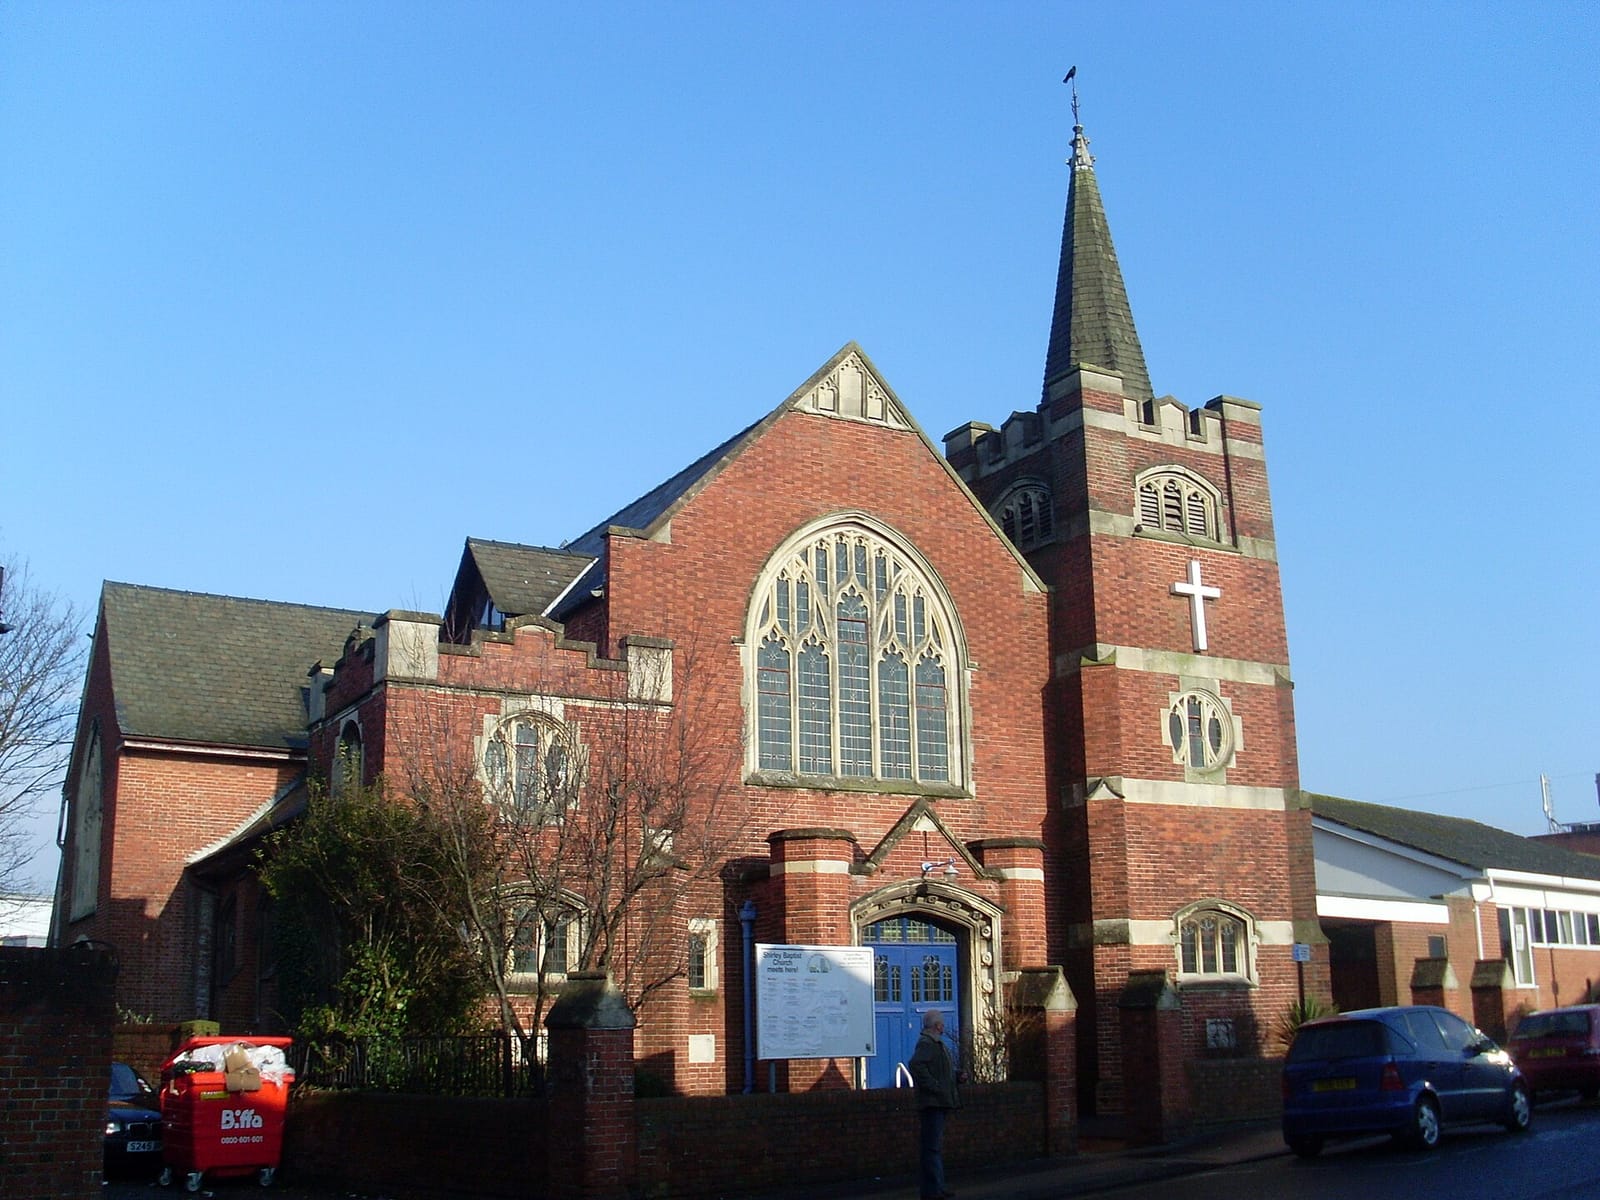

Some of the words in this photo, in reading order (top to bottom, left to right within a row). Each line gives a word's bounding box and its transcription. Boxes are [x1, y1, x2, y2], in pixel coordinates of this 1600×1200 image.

[763, 951, 782, 959] Shirley
[783, 951, 802, 959] Baptist
[221, 1108, 263, 1130] Biffa
